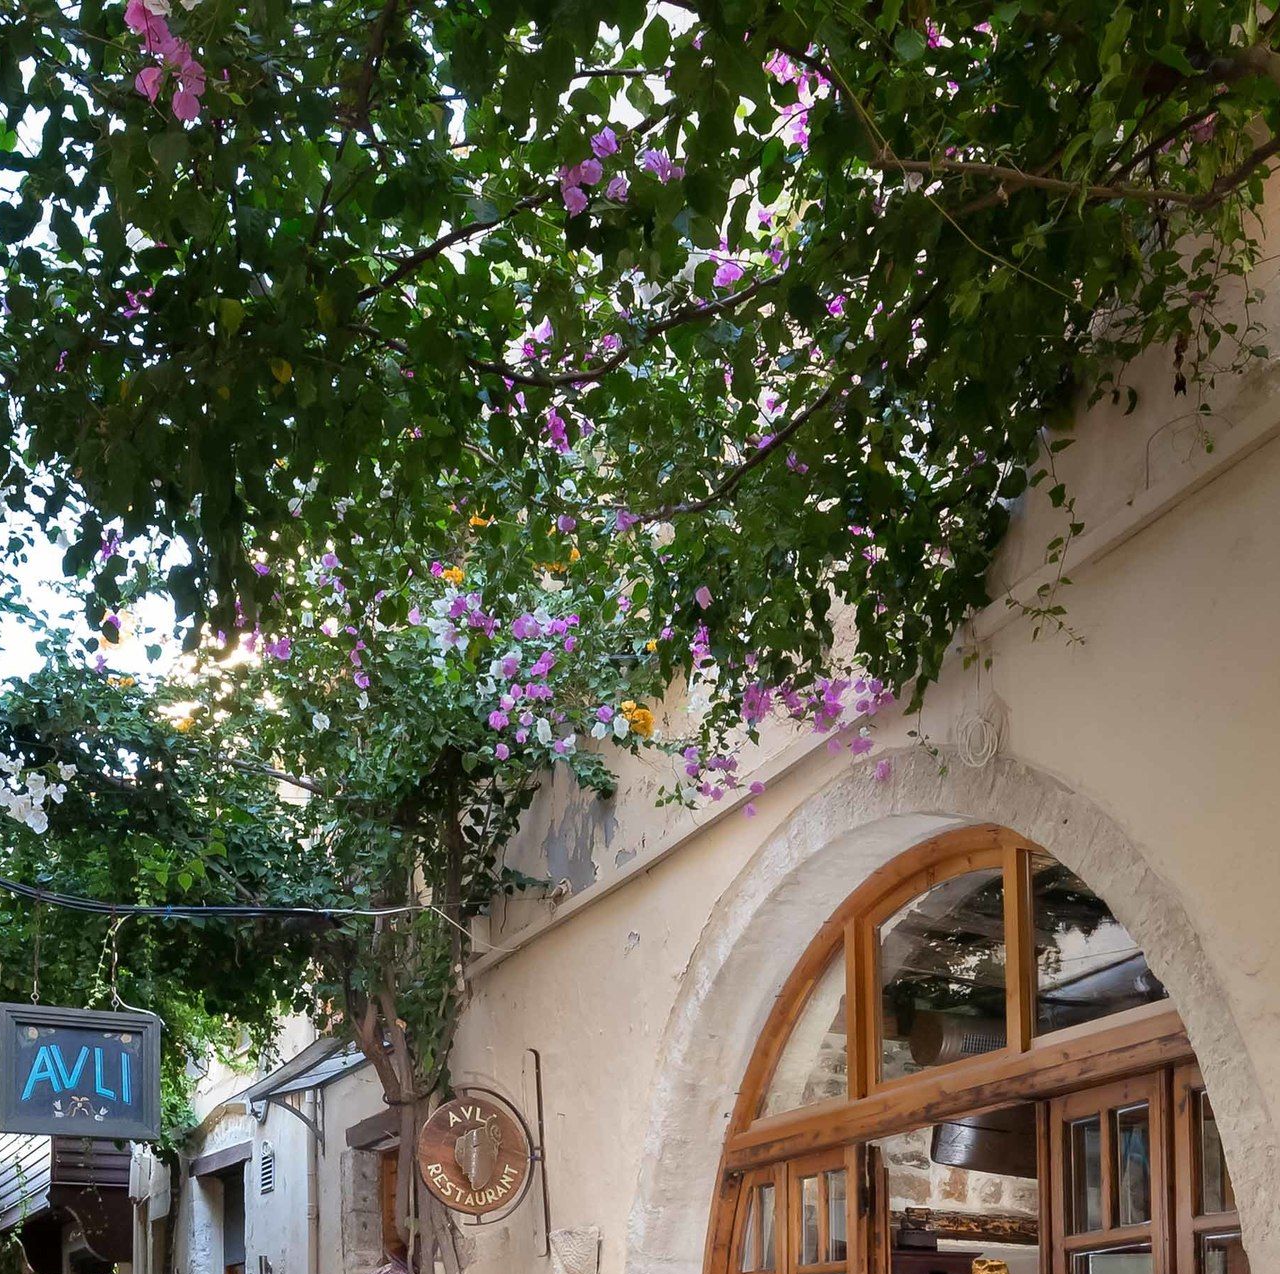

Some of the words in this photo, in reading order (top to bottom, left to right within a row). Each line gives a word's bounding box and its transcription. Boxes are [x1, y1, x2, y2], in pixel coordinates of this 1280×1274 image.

[21, 1045, 132, 1105] AVLI
[447, 1105, 498, 1128] AVL
[427, 1163, 519, 1207] RESTAURANT
